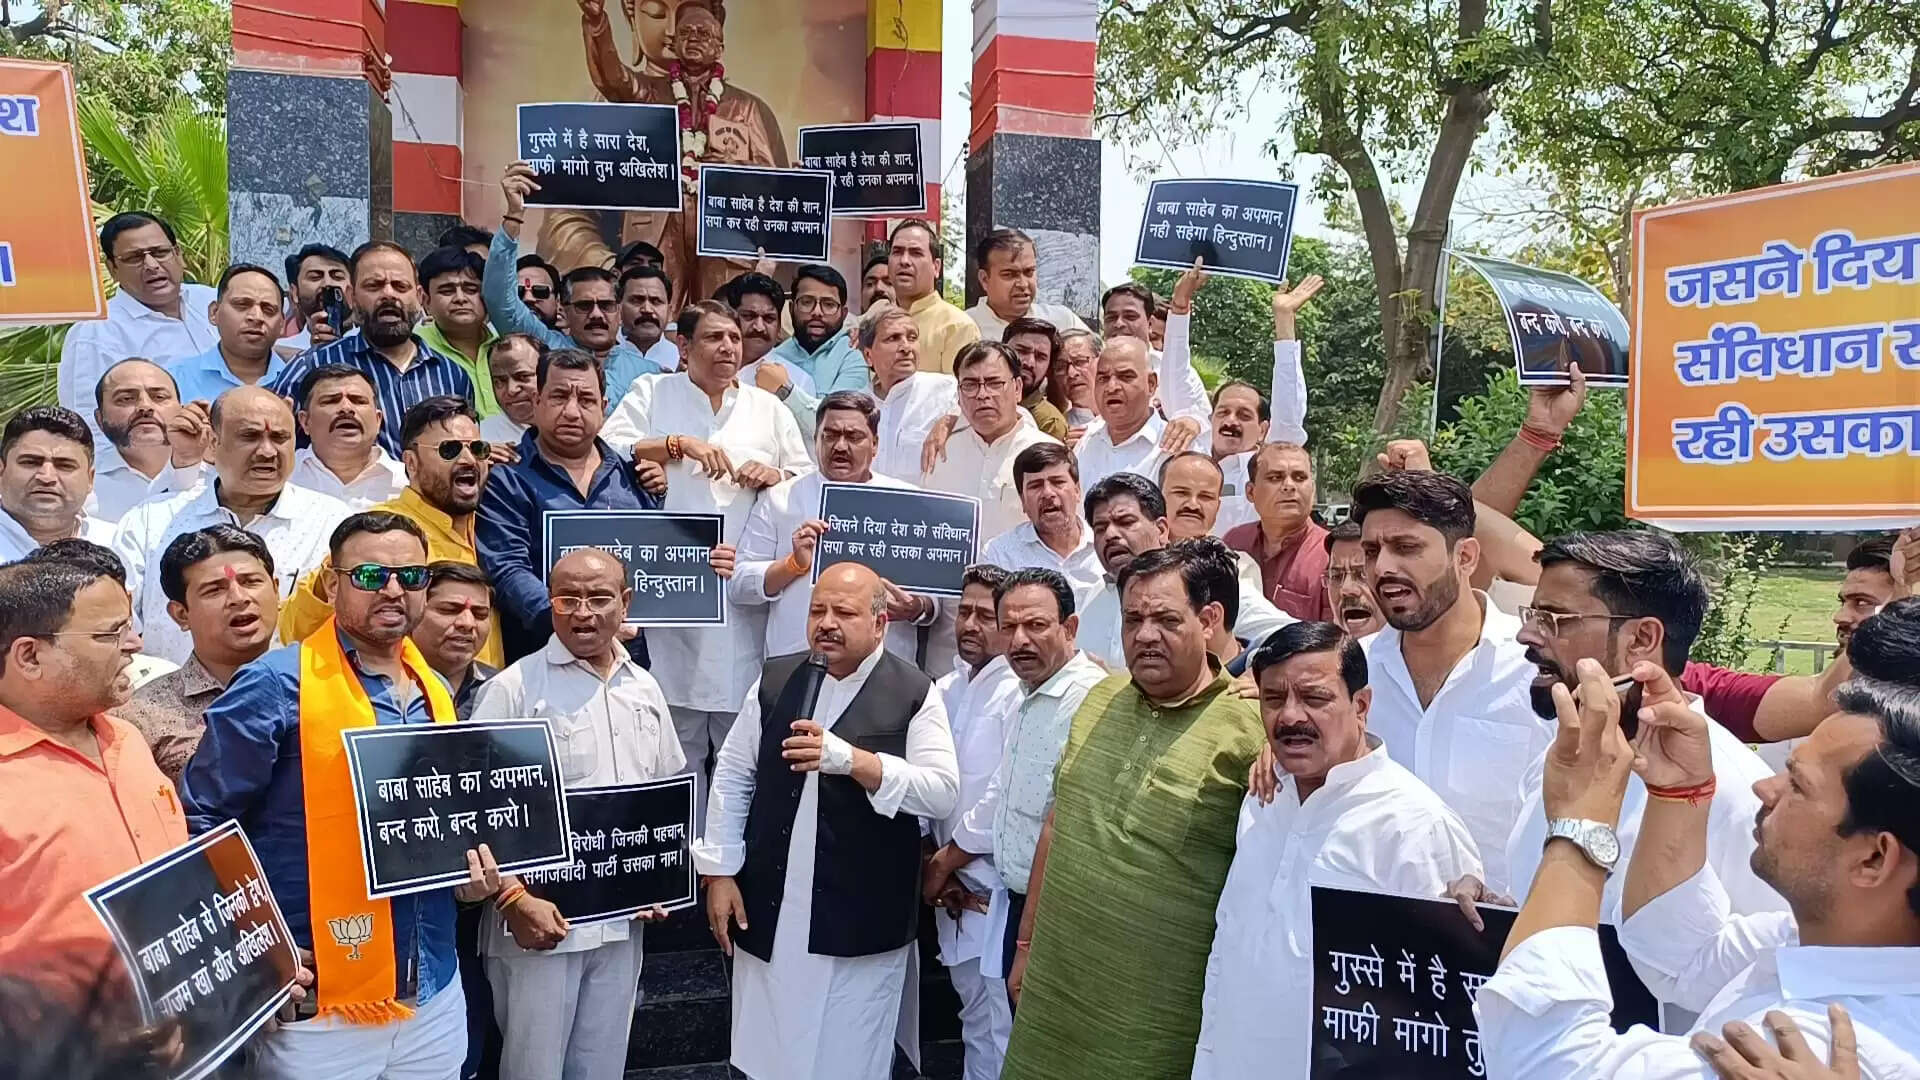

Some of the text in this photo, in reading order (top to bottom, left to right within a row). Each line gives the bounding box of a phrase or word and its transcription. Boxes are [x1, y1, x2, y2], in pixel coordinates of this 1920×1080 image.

[528, 128, 650, 153] गुस्से में है सारा देश,
[561, 154, 590, 176] मांगो
[594, 160, 614, 182] तुम
[804, 156, 821, 168] बाबा
[824, 152, 847, 168] साहेब
[850, 151, 857, 168] है
[860, 151, 875, 167] देश
[878, 151, 890, 167] की
[840, 172, 854, 187] रही
[857, 174, 882, 186] उनका
[707, 195, 726, 210] बाबा
[730, 193, 754, 211] साहेब
[757, 195, 765, 213] है
[769, 196, 784, 213] देश
[787, 197, 799, 214] की
[1156, 197, 1284, 229] बाबा साहेब का अपमान,
[705, 215, 722, 229] सपा
[726, 217, 741, 231] कर
[744, 216, 759, 231] रही
[763, 220, 788, 233] उनका
[1149, 220, 1171, 239] नही
[1175, 220, 1208, 241] सहेगा
[1813, 233, 1920, 289] दिय
[1677, 325, 1884, 382] संविधान
[1675, 405, 1755, 460] रही
[828, 514, 859, 533] जिसने
[863, 517, 887, 536] दिया
[891, 518, 908, 537] देश
[913, 520, 927, 538] को
[639, 544, 658, 563] का
[823, 540, 843, 555] सपा
[848, 542, 865, 557] कर
[868, 540, 887, 558] रही
[890, 545, 922, 560] उसका
[376, 764, 548, 802] बाबा साहेब का अपमान,
[377, 819, 408, 845] बन्द
[412, 808, 444, 841] करो,
[448, 811, 478, 835] बन्द
[611, 824, 649, 849] जिनकी
[653, 822, 686, 842] पहचान,
[591, 854, 618, 878] पार्टी
[622, 853, 657, 874] उसका
[138, 937, 171, 975] बाबा
[167, 913, 204, 956] साहेब
[199, 900, 218, 935] से
[213, 880, 251, 927] जिनको
[211, 945, 238, 983] और
[1328, 943, 1385, 995] गुस्से
[1396, 948, 1417, 993] में
[1427, 954, 1448, 1000] है
[1322, 1001, 1485, 1076] माफी मांगो तु
